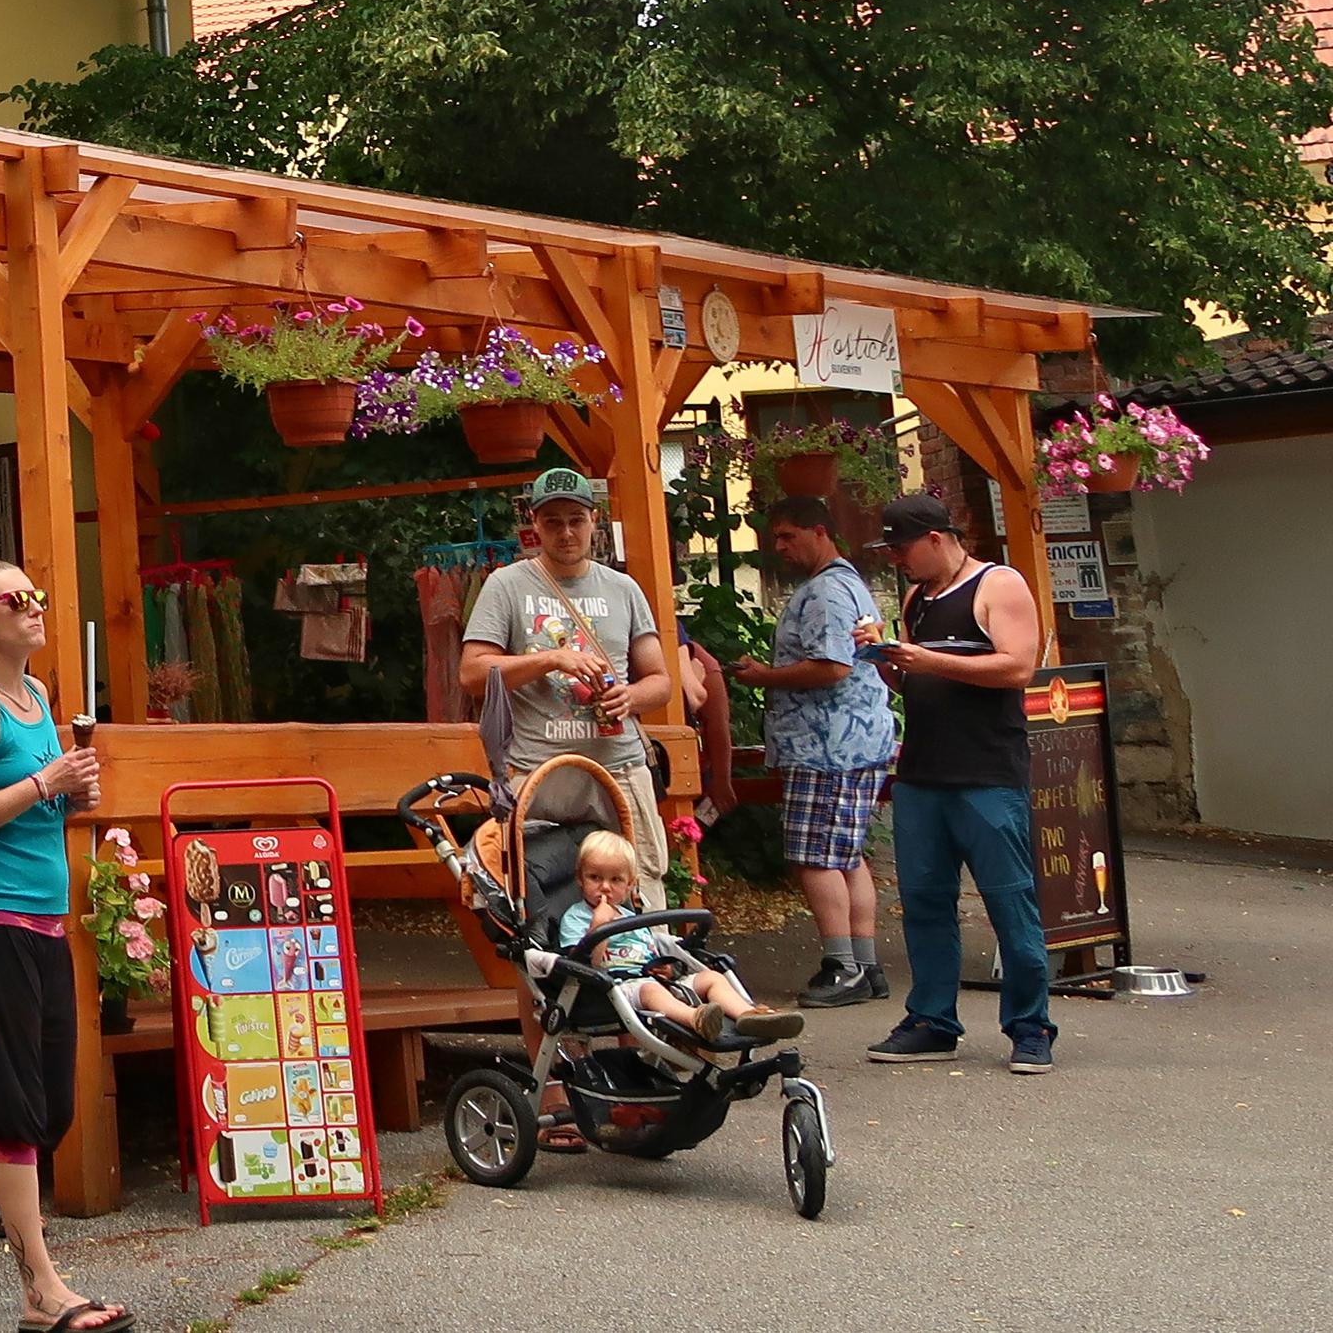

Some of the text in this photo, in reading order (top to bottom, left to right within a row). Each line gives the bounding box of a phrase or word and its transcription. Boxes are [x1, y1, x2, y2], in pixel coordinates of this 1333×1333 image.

[1046, 542, 1097, 560] ENICTVÍ
[525, 594, 535, 614] A
[545, 720, 599, 740] CHRIST
